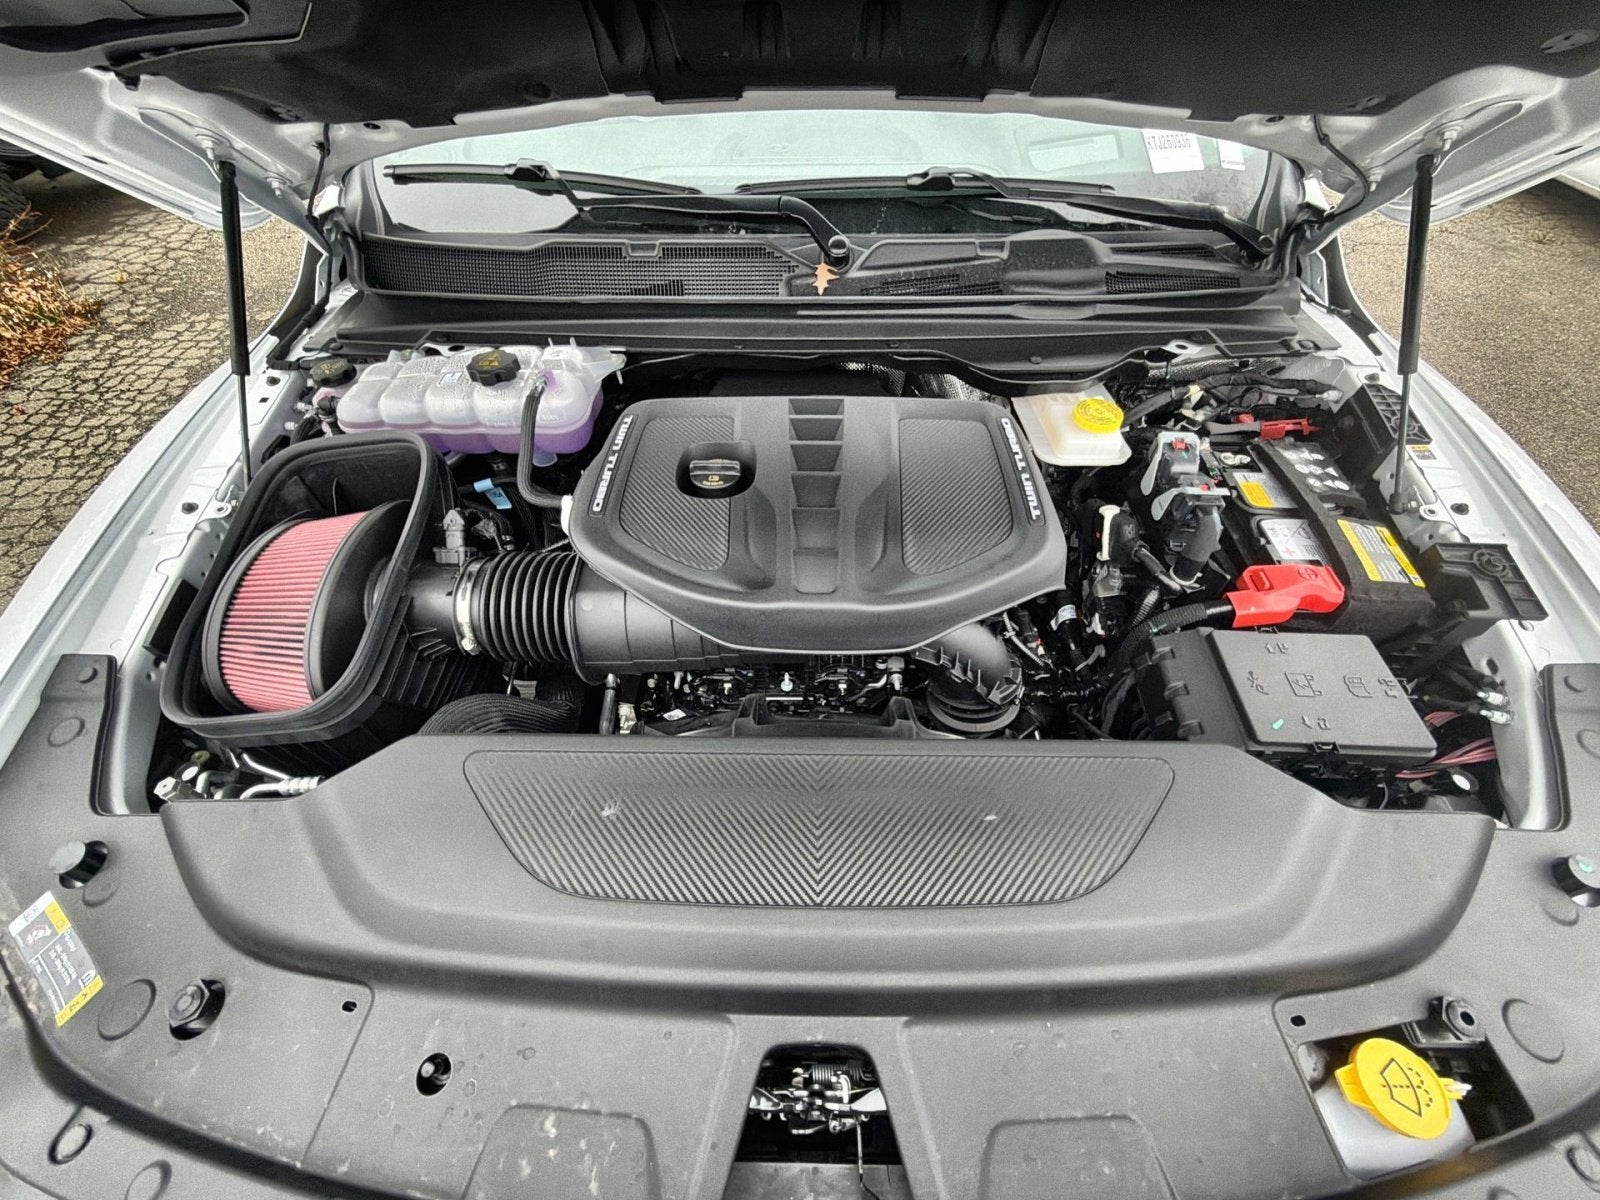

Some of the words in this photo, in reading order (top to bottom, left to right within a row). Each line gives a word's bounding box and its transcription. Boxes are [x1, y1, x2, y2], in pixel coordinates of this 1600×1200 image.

[612, 414, 634, 451] TWIN
[1001, 417, 1026, 471] TURBO
[592, 452, 619, 512] TURBO
[1020, 473, 1041, 520] TWIN
